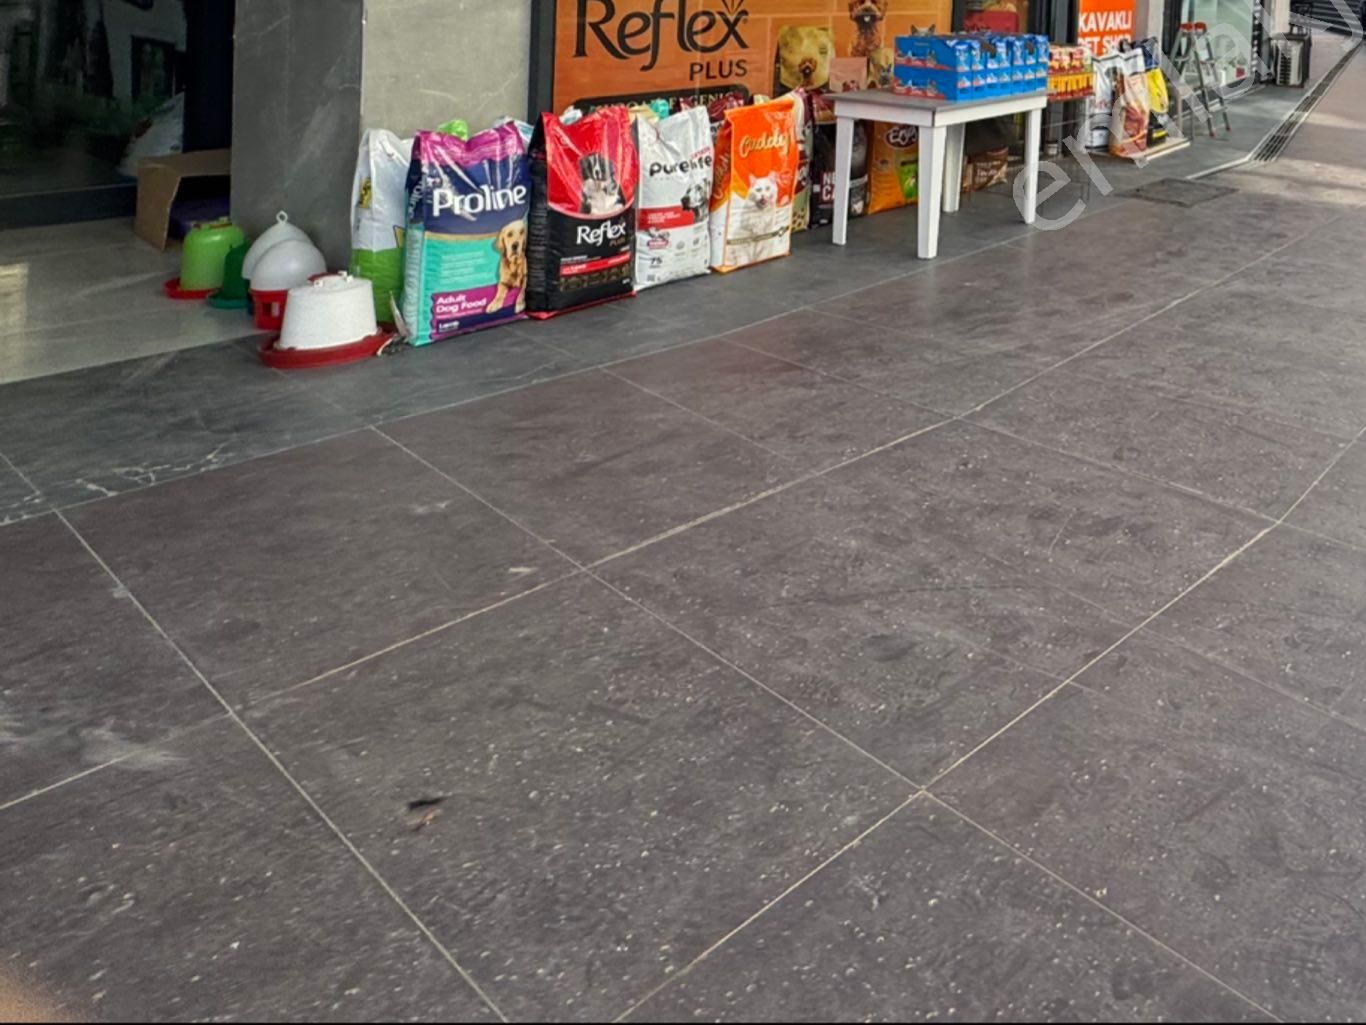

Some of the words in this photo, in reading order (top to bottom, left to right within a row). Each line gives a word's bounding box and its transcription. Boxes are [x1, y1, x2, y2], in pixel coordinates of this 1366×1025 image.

[1078, 10, 1132, 33] KAVAKLI
[689, 59, 748, 82] PLUS
[432, 184, 527, 217] Proline
[576, 220, 626, 247] Reflex
[436, 294, 466, 305] Adult
[436, 304, 459, 313] Dog
[461, 297, 487, 310] Food
